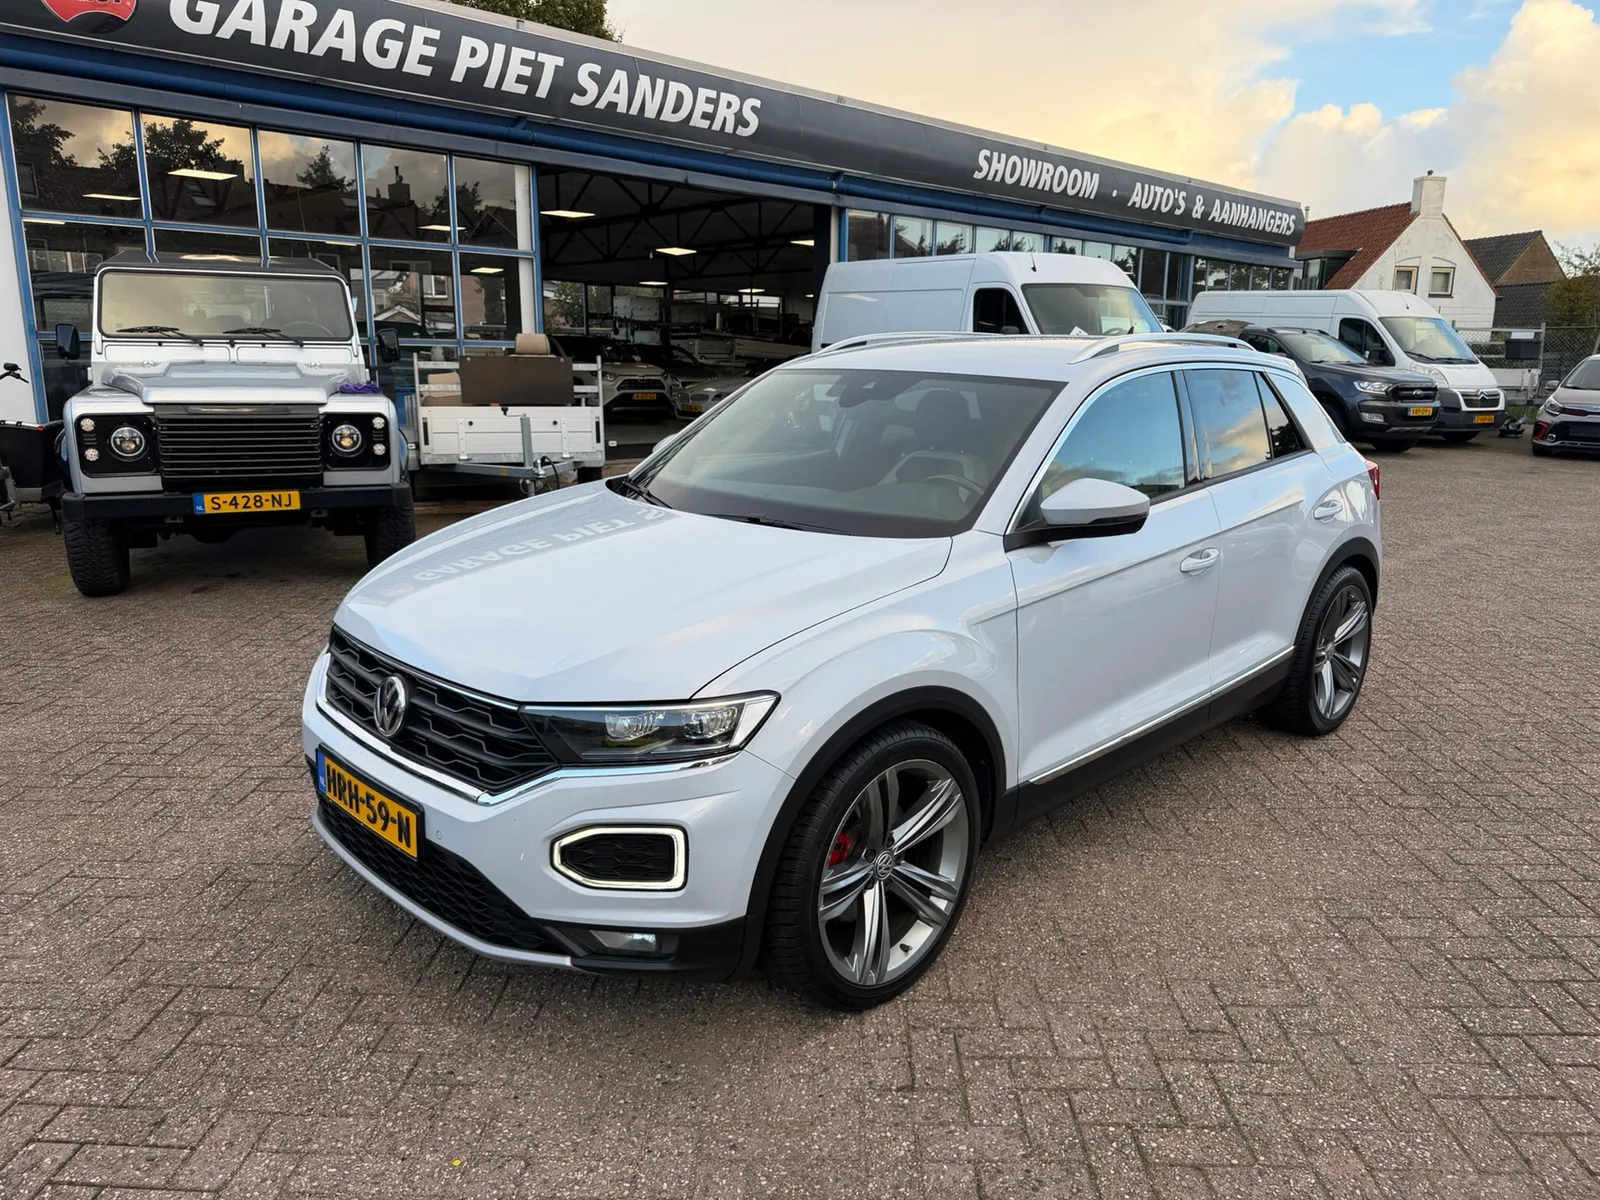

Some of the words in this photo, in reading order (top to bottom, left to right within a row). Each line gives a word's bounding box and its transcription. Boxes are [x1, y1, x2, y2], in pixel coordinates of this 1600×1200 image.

[169, 0, 441, 76] GARAGE
[450, 35, 564, 99] PIET
[569, 62, 762, 137] SANDERS
[973, 148, 1100, 199] SHOWROOM
[1127, 182, 1187, 216] AUTO'S
[1192, 194, 1204, 219] &
[1208, 199, 1297, 236] AANHANGERS
[210, 493, 293, 511] S-428-NJ
[326, 763, 412, 849] HRH-59-N
